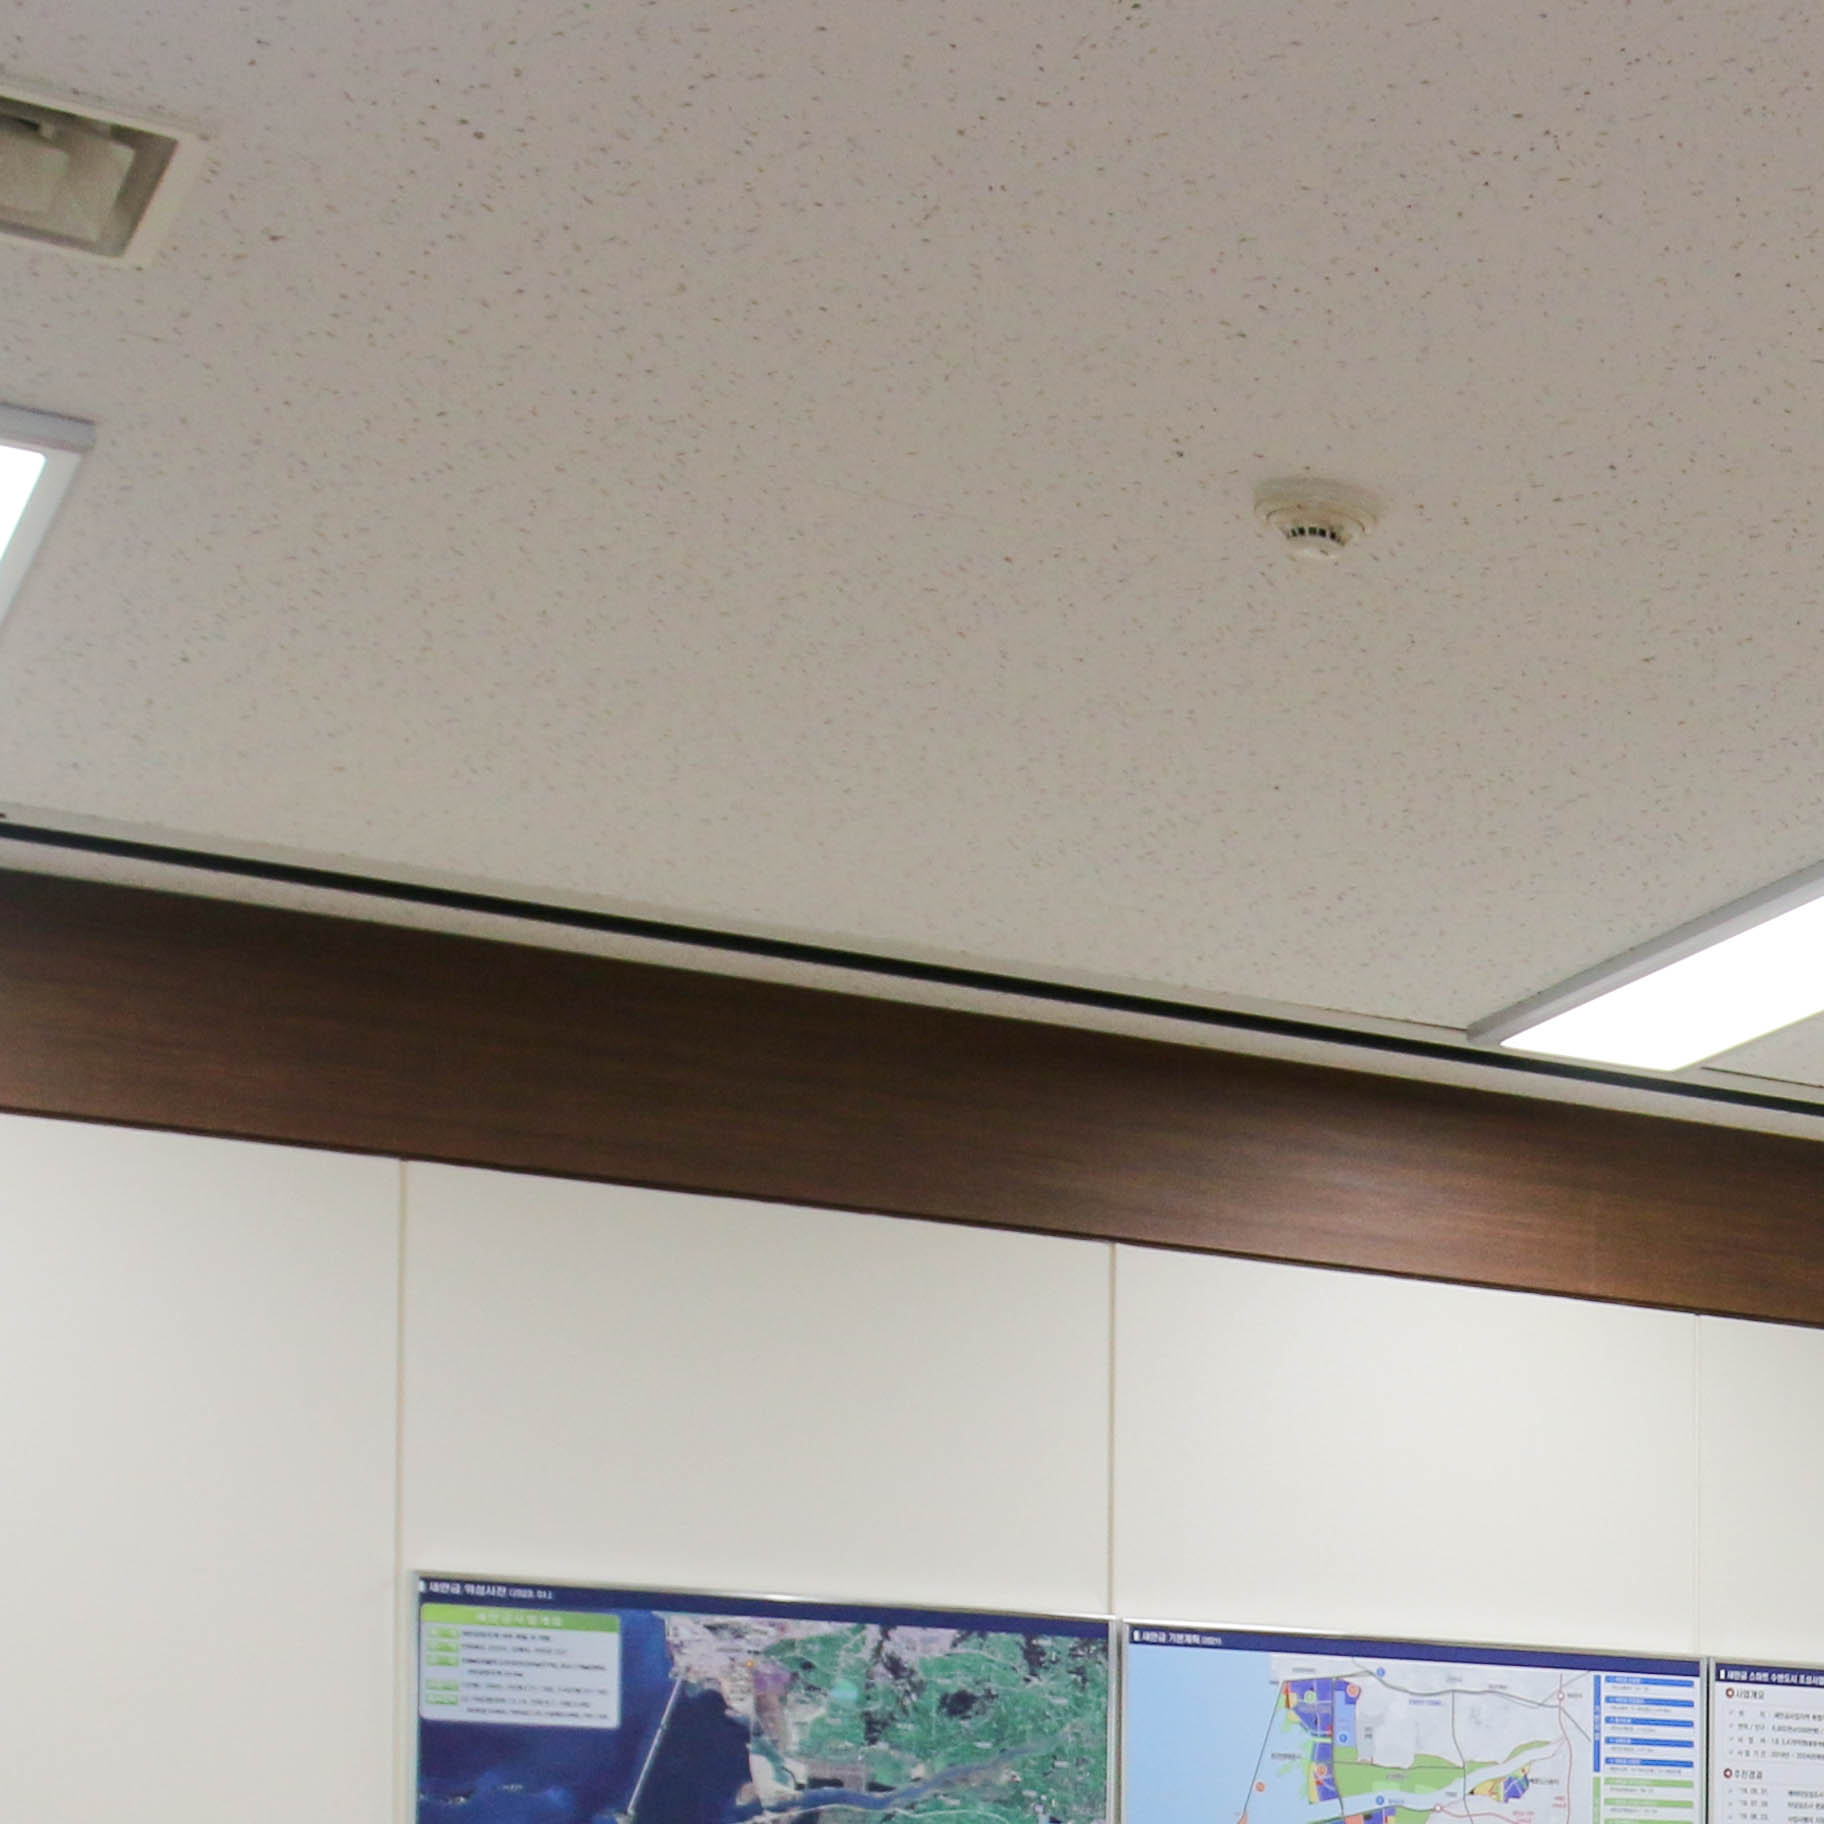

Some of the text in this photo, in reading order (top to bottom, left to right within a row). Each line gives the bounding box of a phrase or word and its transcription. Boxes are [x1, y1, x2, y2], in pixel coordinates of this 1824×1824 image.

[1141, 1630, 1166, 1643] 새만금
[1727, 1670, 1747, 1681] 새만금
[1749, 1671, 1769, 1682] 스마트
[1770, 1673, 1798, 1684] 수변도시
[1736, 1689, 1765, 1700] 사업개요
